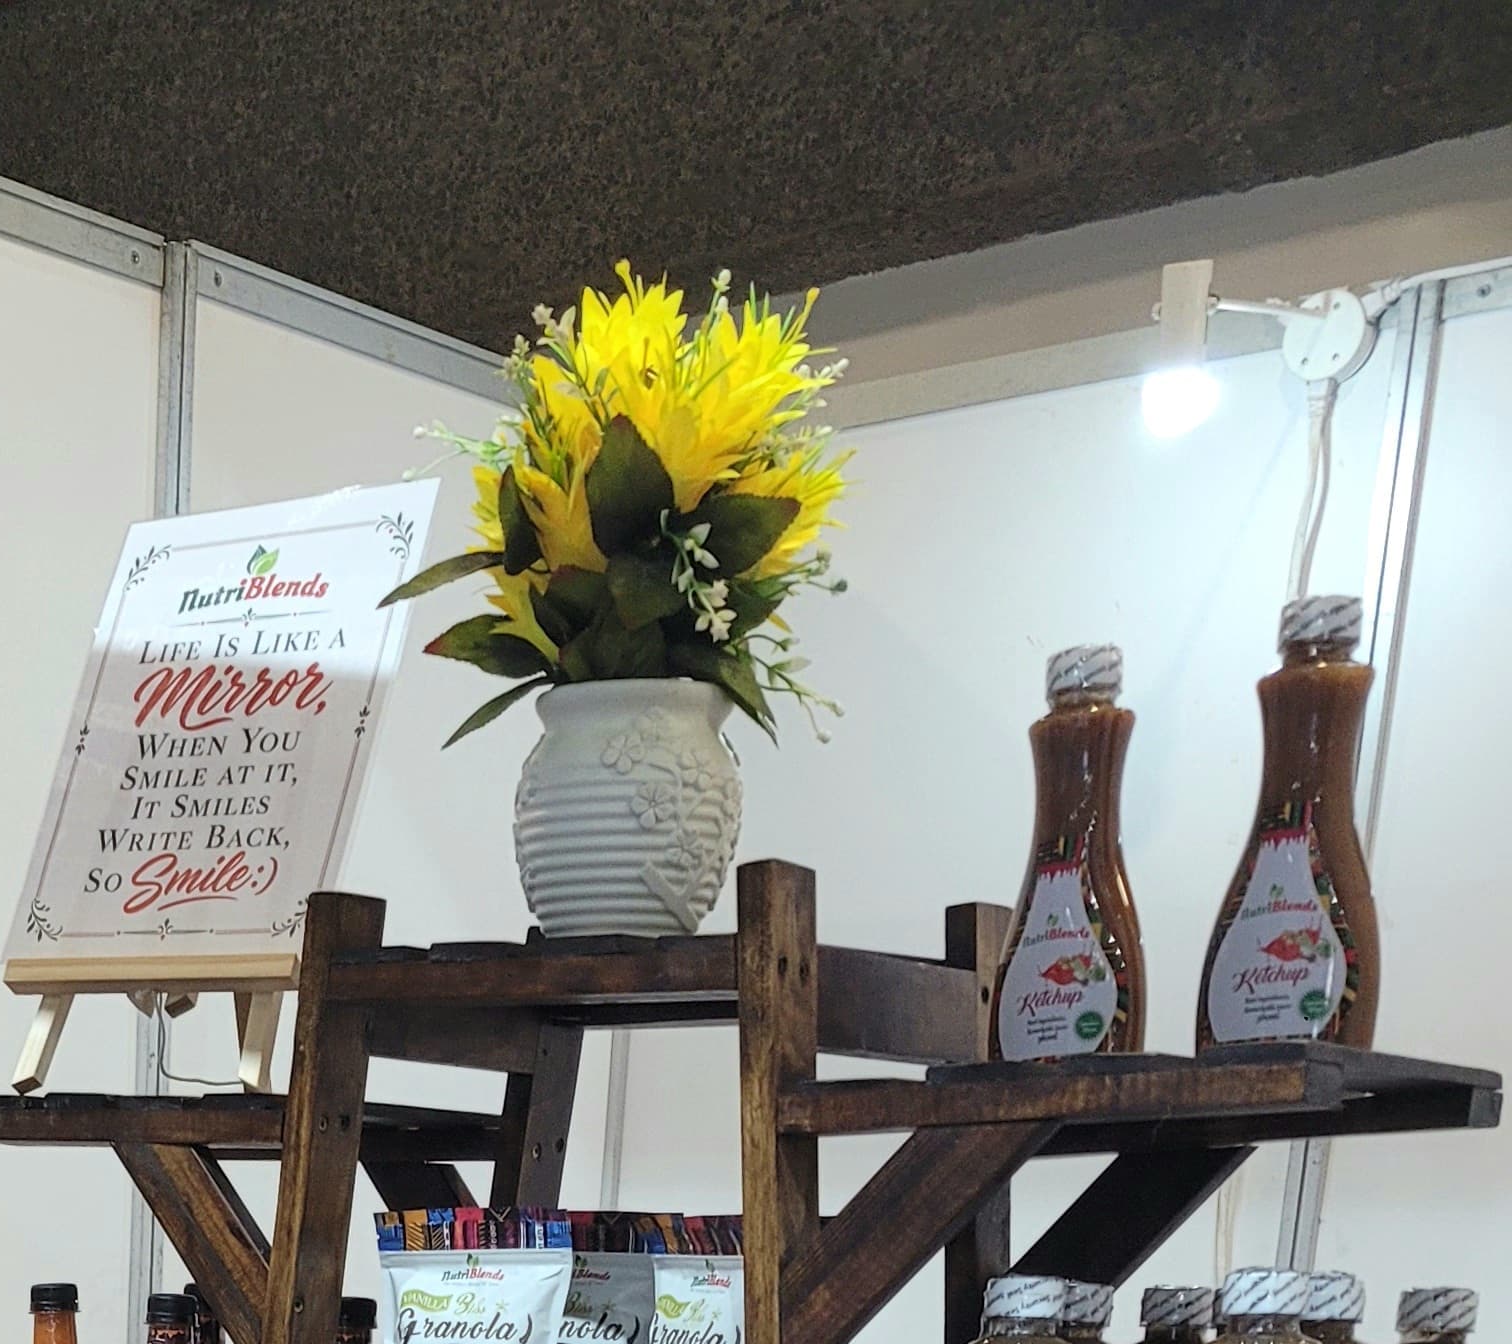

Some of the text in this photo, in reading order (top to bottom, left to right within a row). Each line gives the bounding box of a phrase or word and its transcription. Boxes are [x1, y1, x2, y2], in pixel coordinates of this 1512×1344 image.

[327, 628, 346, 649] A
[133, 661, 334, 731] Mirror,
[1232, 965, 1310, 994] Ketchup
[559, 1311, 624, 1340] nola
